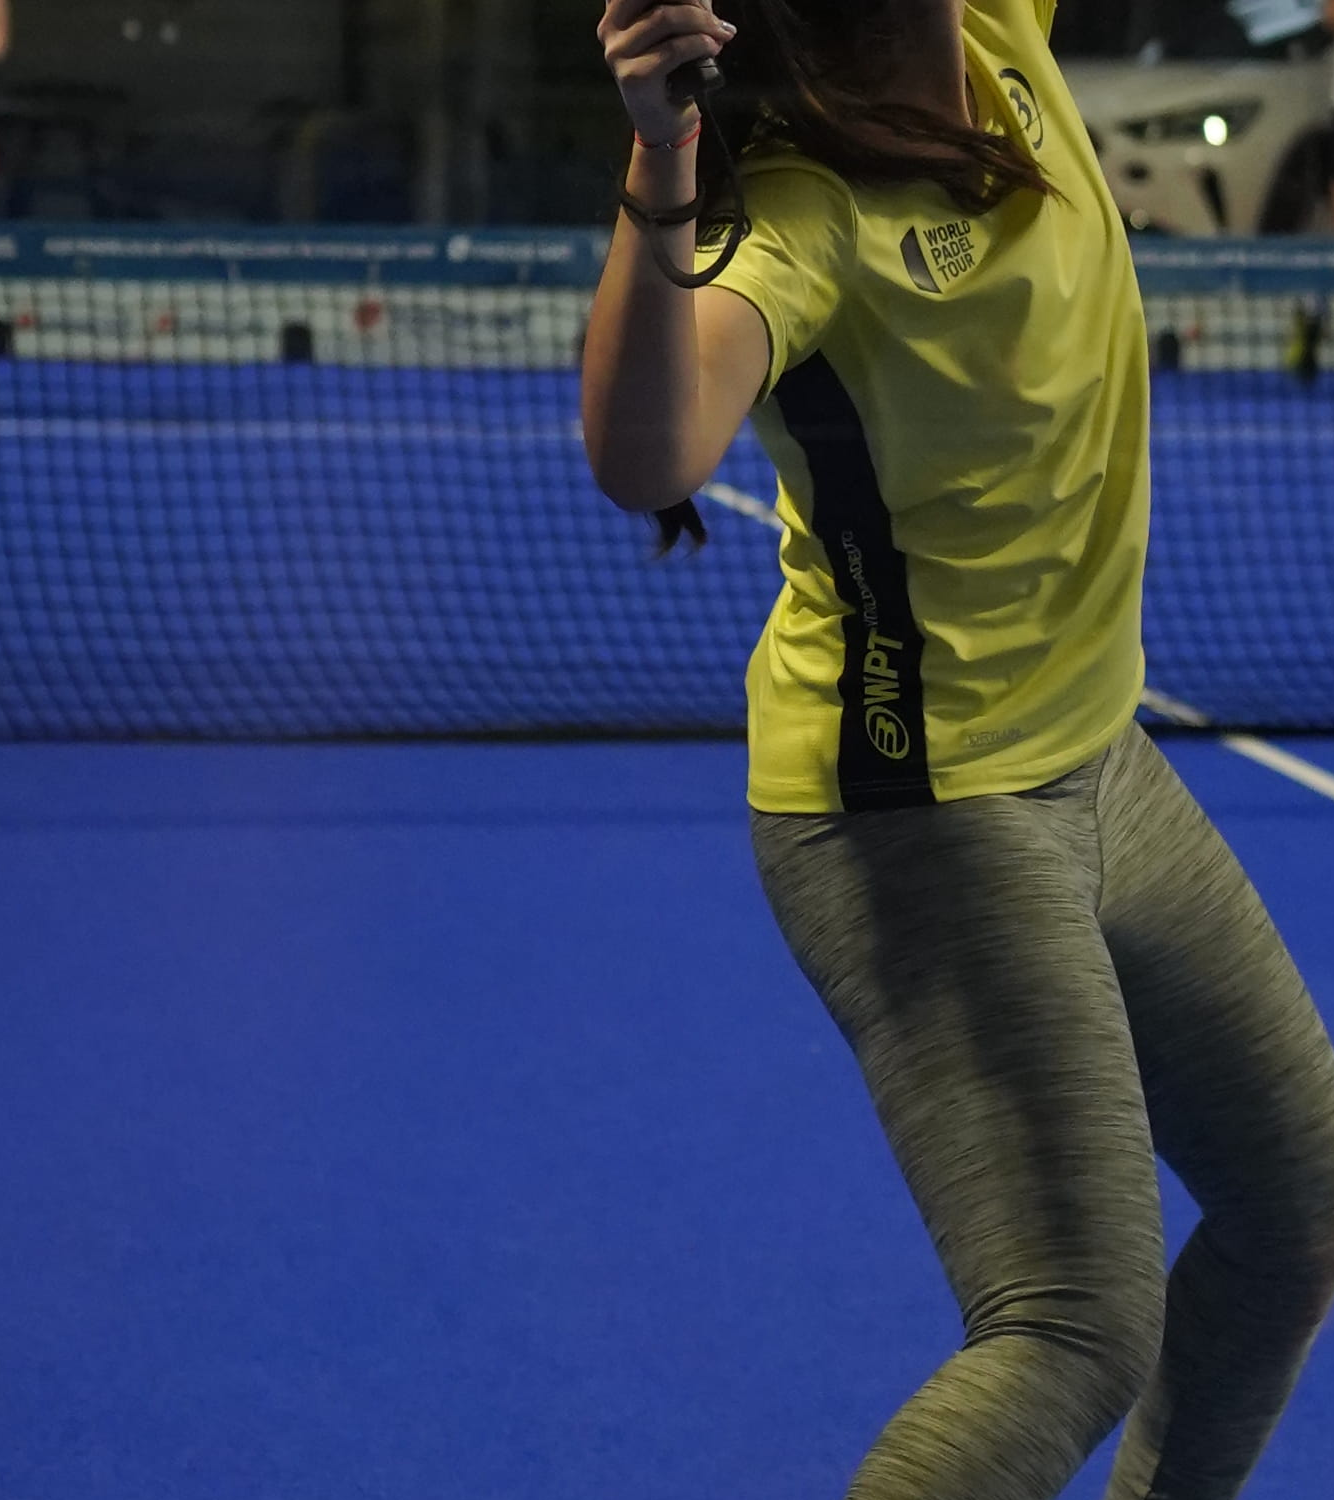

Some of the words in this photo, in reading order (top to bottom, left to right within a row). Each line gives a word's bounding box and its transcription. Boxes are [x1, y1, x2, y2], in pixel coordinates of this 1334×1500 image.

[922, 219, 971, 247] WORLD
[930, 237, 974, 266] PADEL
[937, 253, 976, 282] TOUR
[863, 627, 904, 707] WPT
